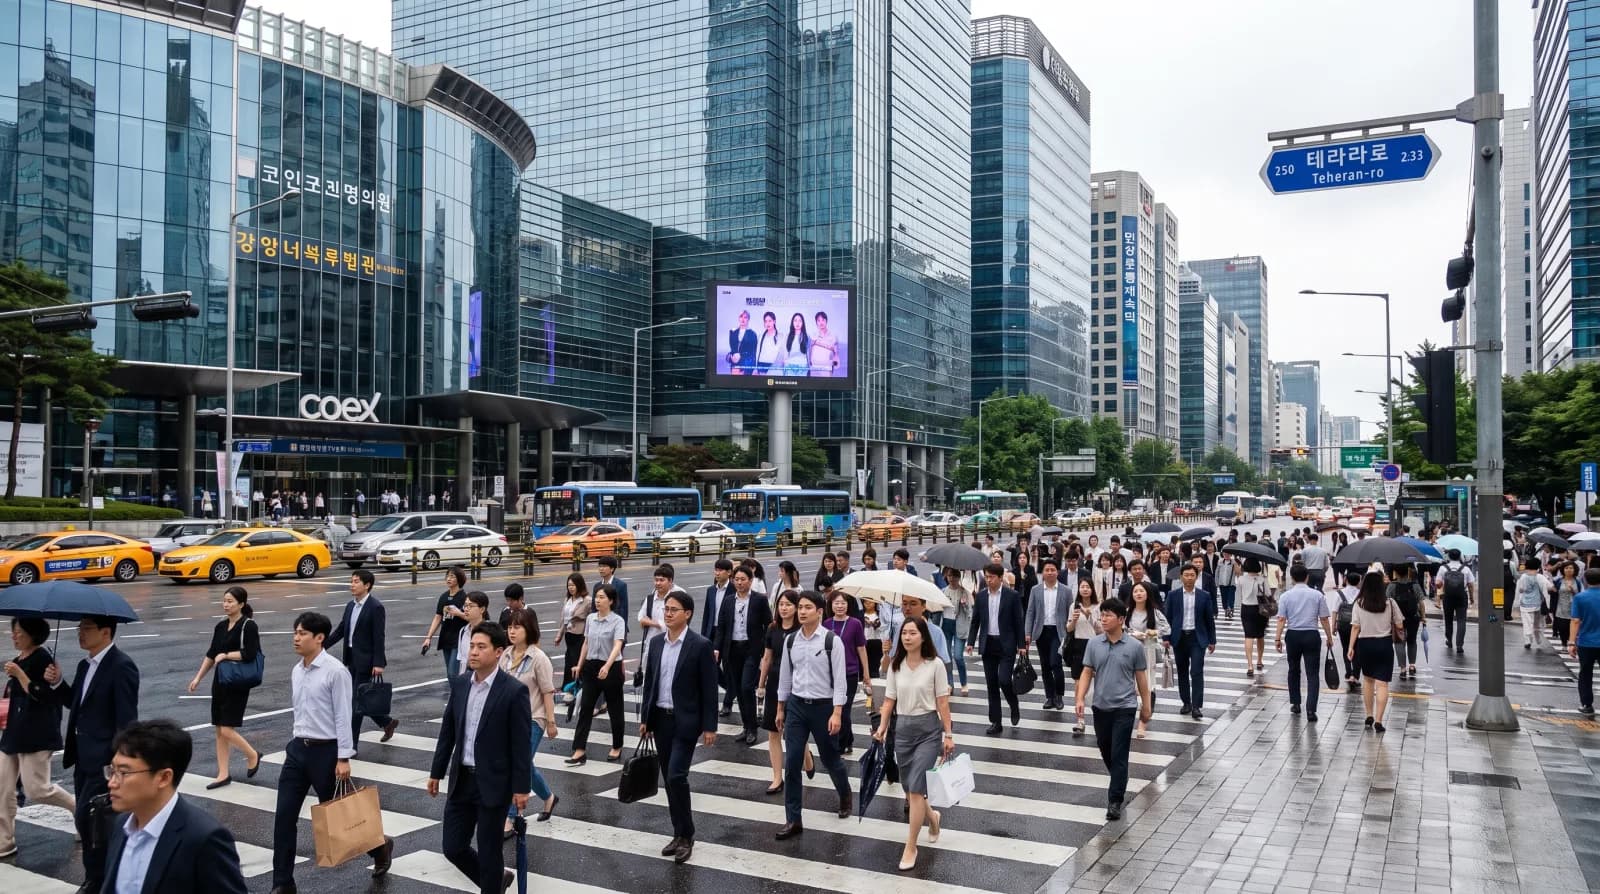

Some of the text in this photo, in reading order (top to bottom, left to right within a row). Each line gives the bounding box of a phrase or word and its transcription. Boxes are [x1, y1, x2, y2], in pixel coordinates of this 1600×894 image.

[1275, 164, 1295, 176] 250
[1306, 143, 1389, 169] 테라라로
[1311, 168, 1384, 185] Teheran-ro
